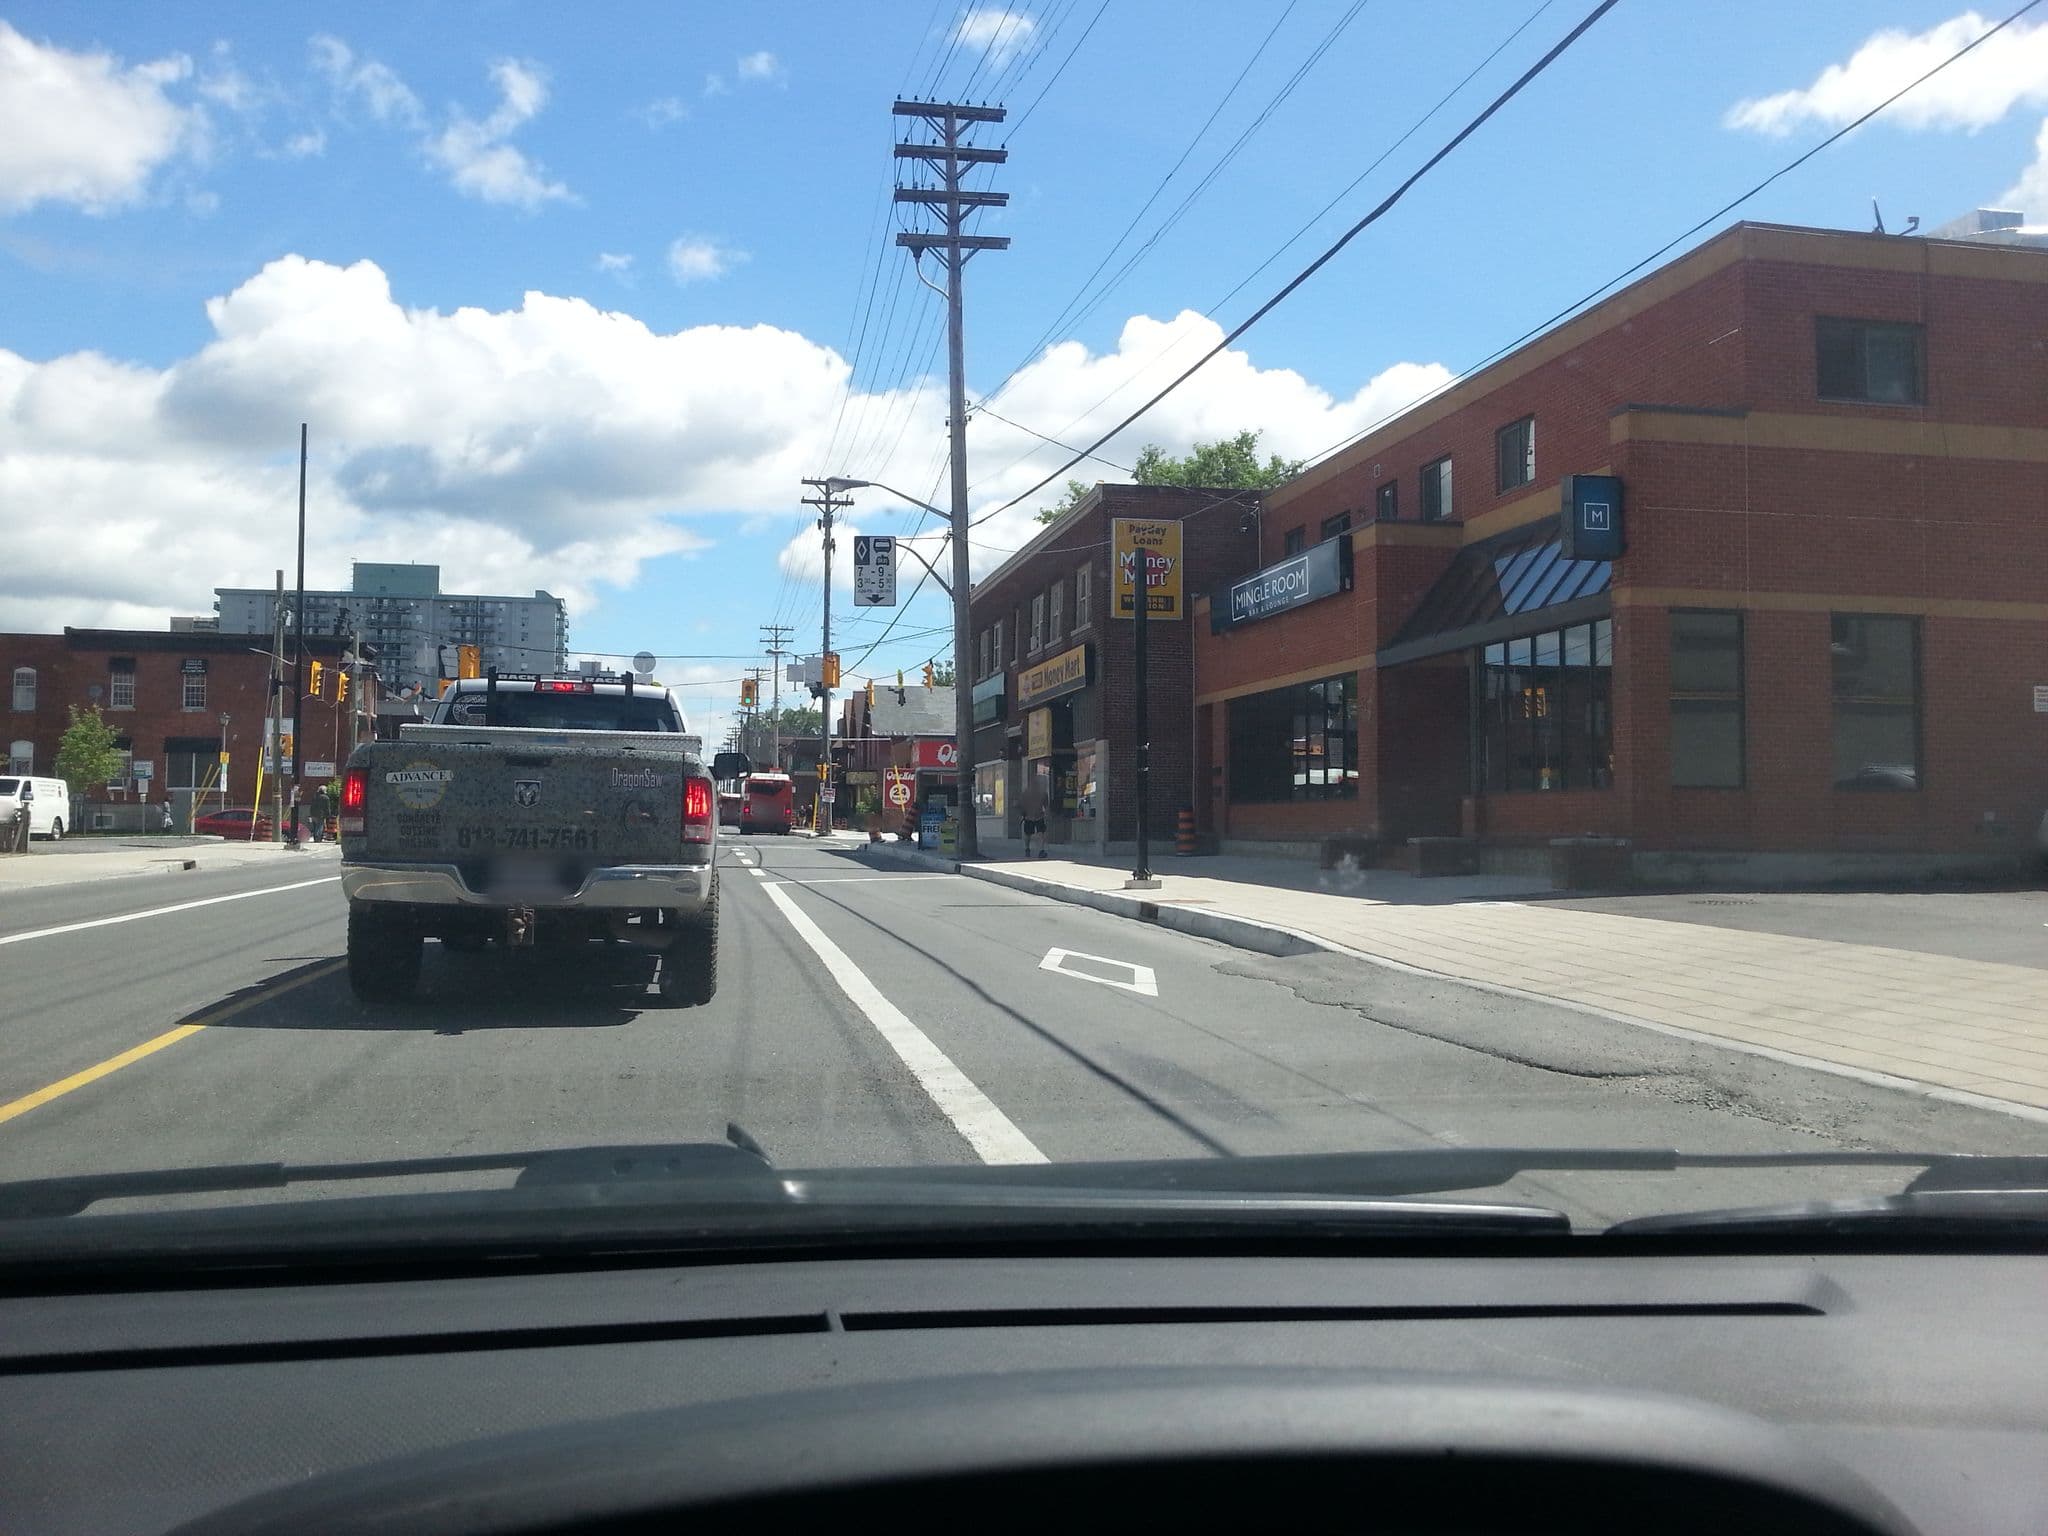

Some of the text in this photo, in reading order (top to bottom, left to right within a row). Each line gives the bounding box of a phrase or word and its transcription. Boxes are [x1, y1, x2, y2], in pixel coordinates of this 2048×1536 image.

[1592, 511, 1603, 523] M
[1129, 524, 1166, 536] Payday
[1133, 536, 1163, 546] Loans
[1120, 551, 1176, 574] Mney
[858, 567, 863, 576] 7
[878, 567, 884, 576] 9
[878, 578, 884, 588] 5
[1124, 569, 1167, 586] Mrt
[1235, 568, 1305, 611] MINGLE ROOM
[584, 676, 623, 684] RACK
[390, 771, 449, 782] ADVANCE
[612, 767, 663, 790] DragonSaw
[893, 787, 907, 796] 24
